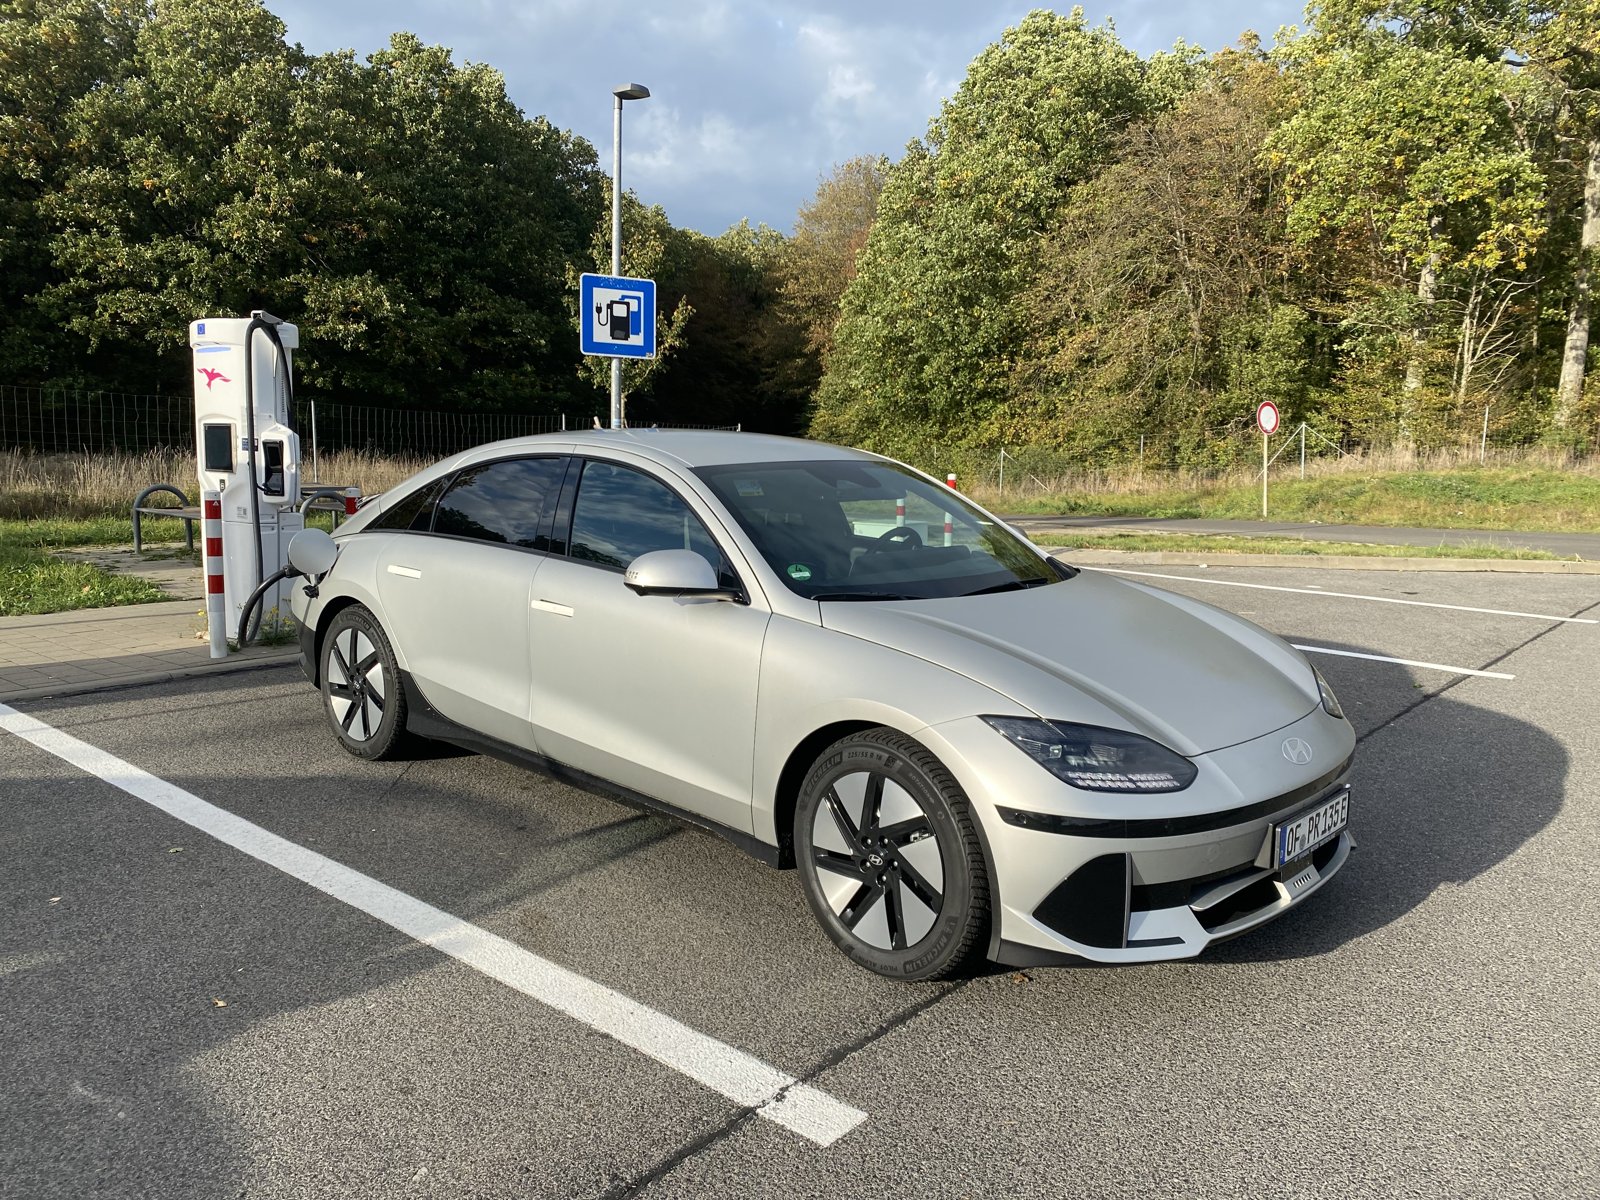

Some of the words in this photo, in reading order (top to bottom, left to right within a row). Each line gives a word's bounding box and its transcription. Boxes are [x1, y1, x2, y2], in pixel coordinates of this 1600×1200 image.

[804, 752, 842, 796] MICHELIN
[848, 751, 868, 759] 225/55
[1287, 823, 1301, 857] OF
[1307, 812, 1321, 844] PR
[1321, 797, 1347, 836] 135E
[903, 935, 948, 974] MICHELIN
